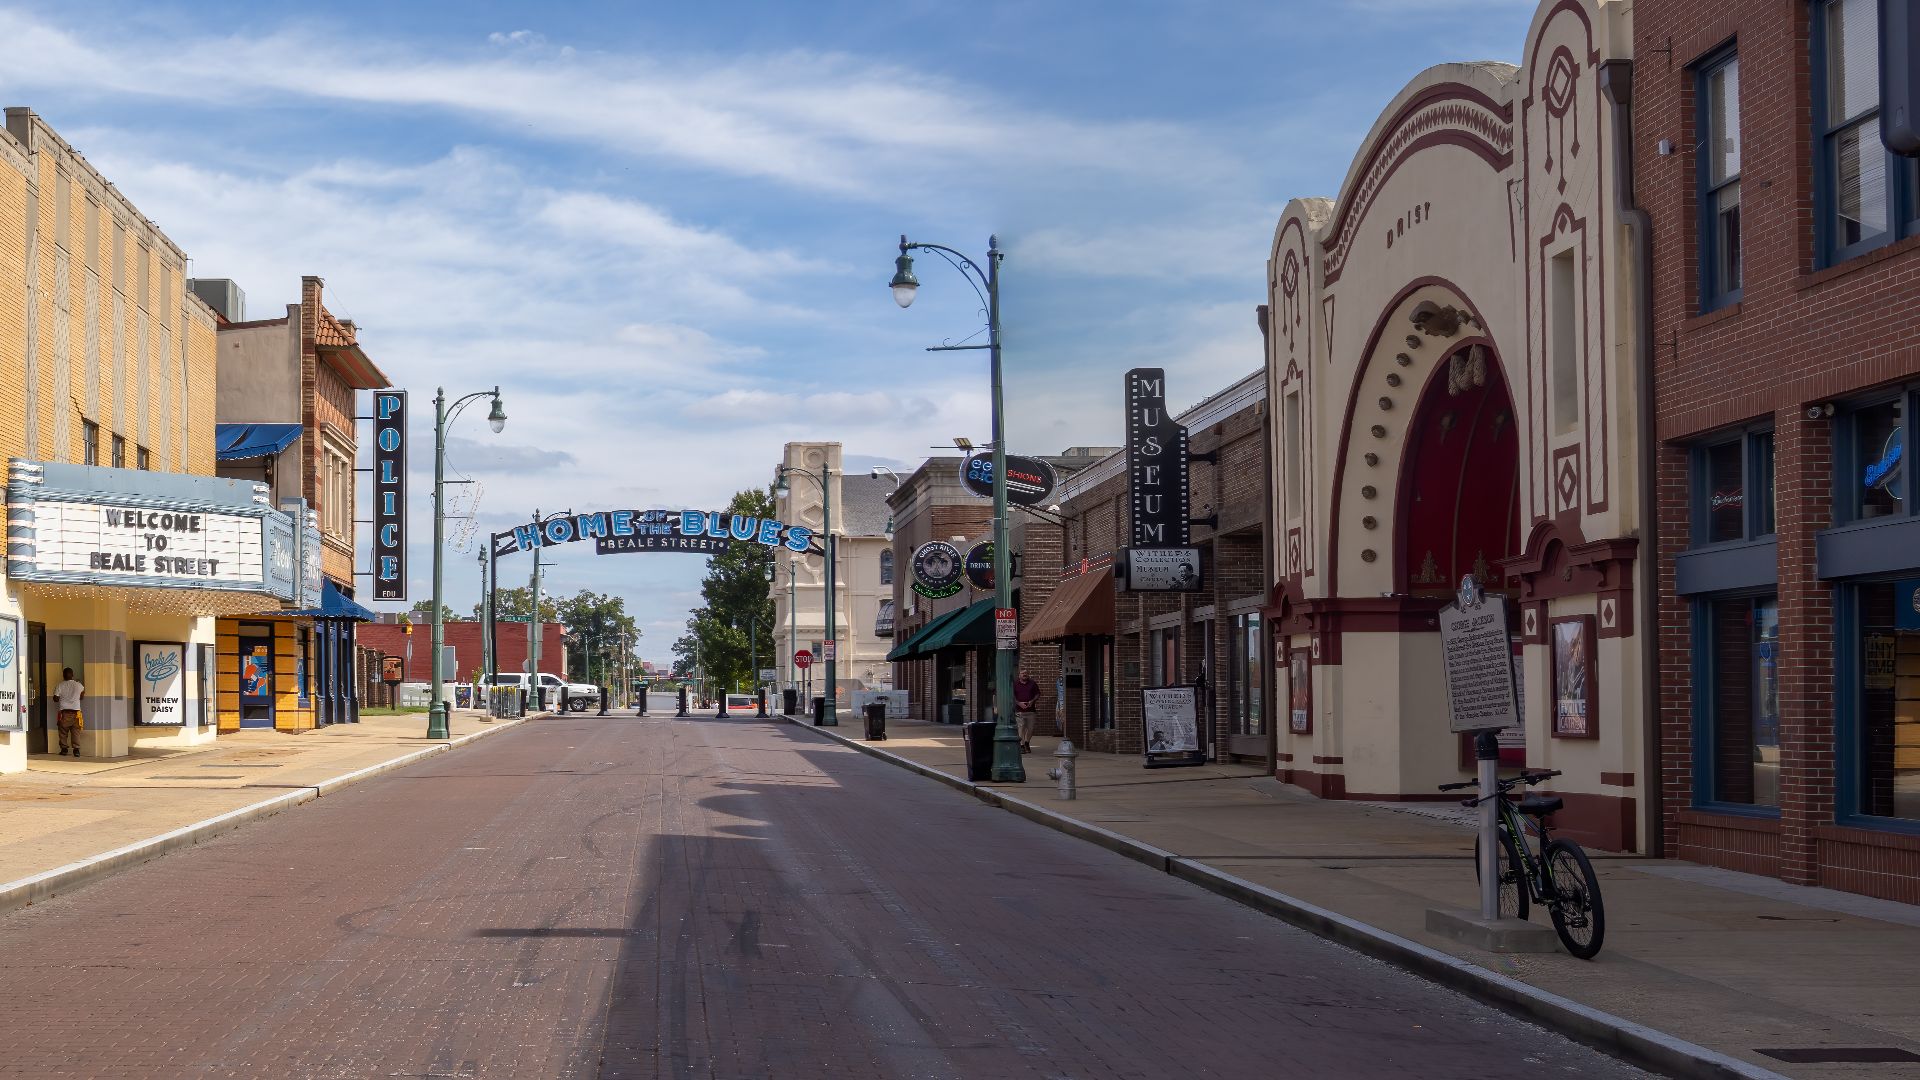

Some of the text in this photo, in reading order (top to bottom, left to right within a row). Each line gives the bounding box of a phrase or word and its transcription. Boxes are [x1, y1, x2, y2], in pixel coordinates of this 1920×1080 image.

[1140, 378, 1165, 543] MUSEUM
[1007, 469, 1042, 483] SHIONS
[378, 395, 400, 582] POLICE
[106, 509, 200, 533] WELCOME
[645, 511, 666, 522] OF
[514, 510, 812, 551] HOME BLUES
[637, 522, 672, 535] THE
[144, 533, 168, 552] TO
[607, 538, 716, 549] BEALE STREET
[90, 551, 220, 576] BEALE STREET
[382, 590, 396, 598] EDU
[1000, 610, 1012, 618] NO
